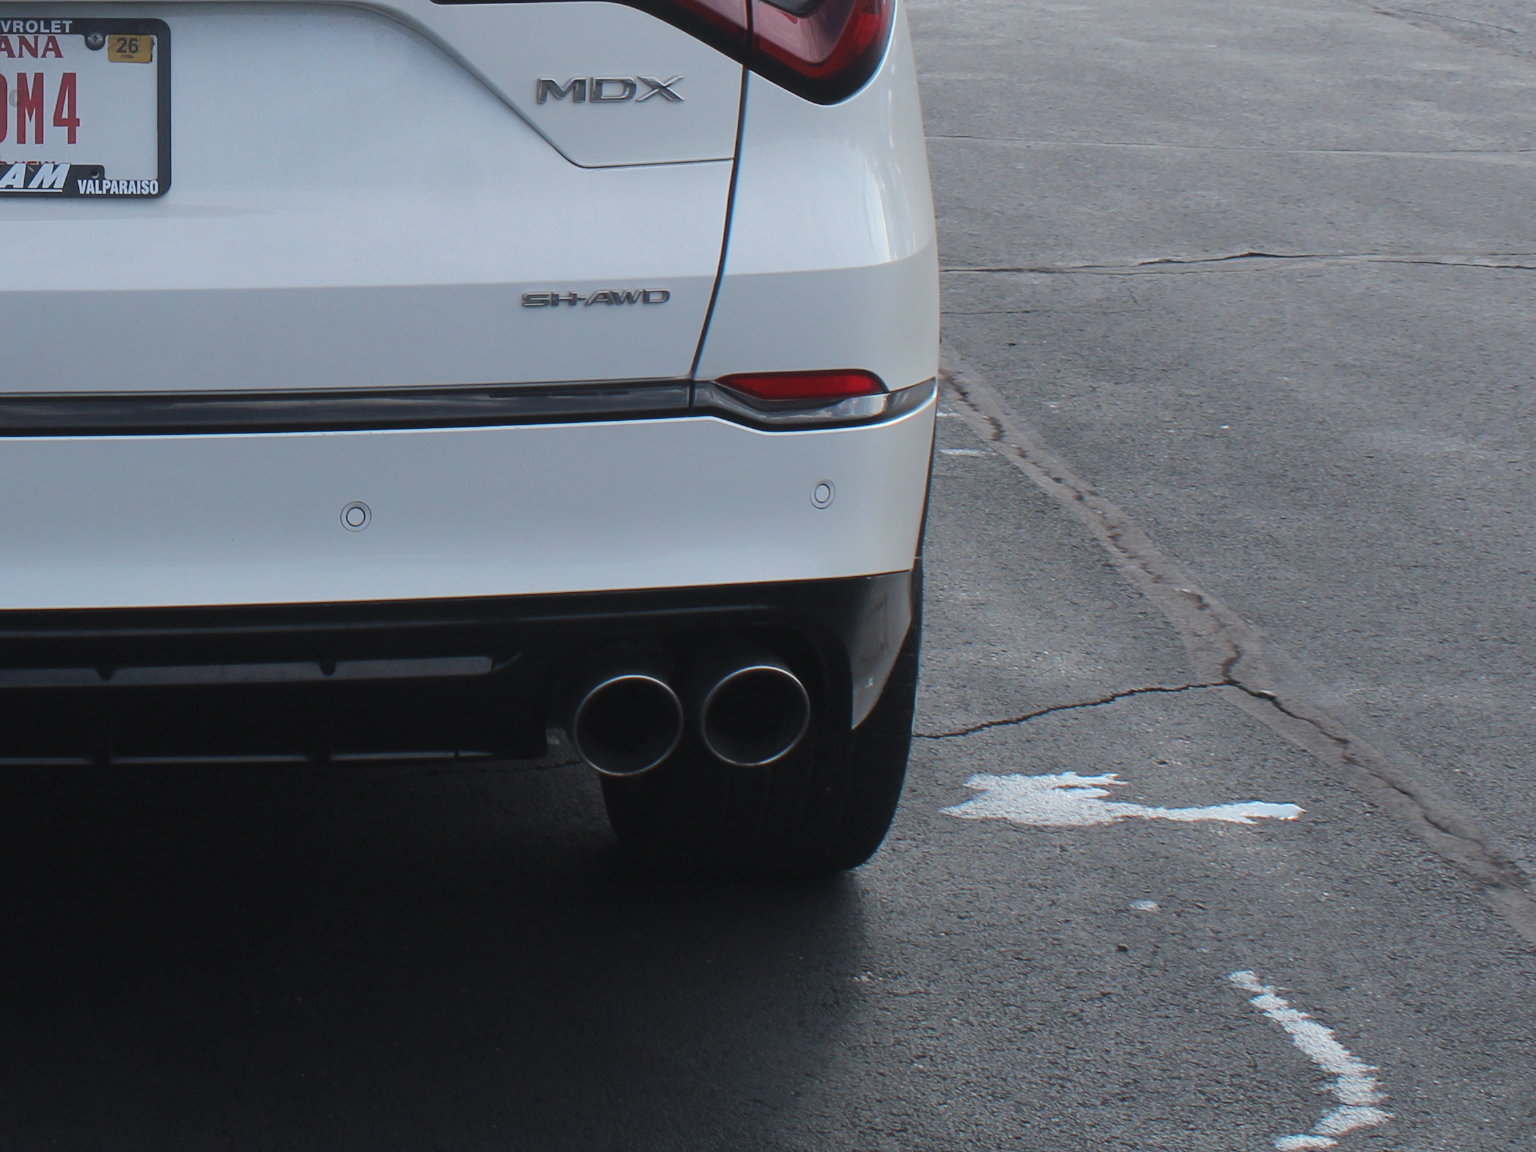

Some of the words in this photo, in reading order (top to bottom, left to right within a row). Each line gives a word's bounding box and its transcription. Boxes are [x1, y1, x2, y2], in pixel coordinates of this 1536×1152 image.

[116, 37, 139, 54] 26
[536, 75, 686, 105] MDX
[77, 179, 159, 196] VALPARAISO
